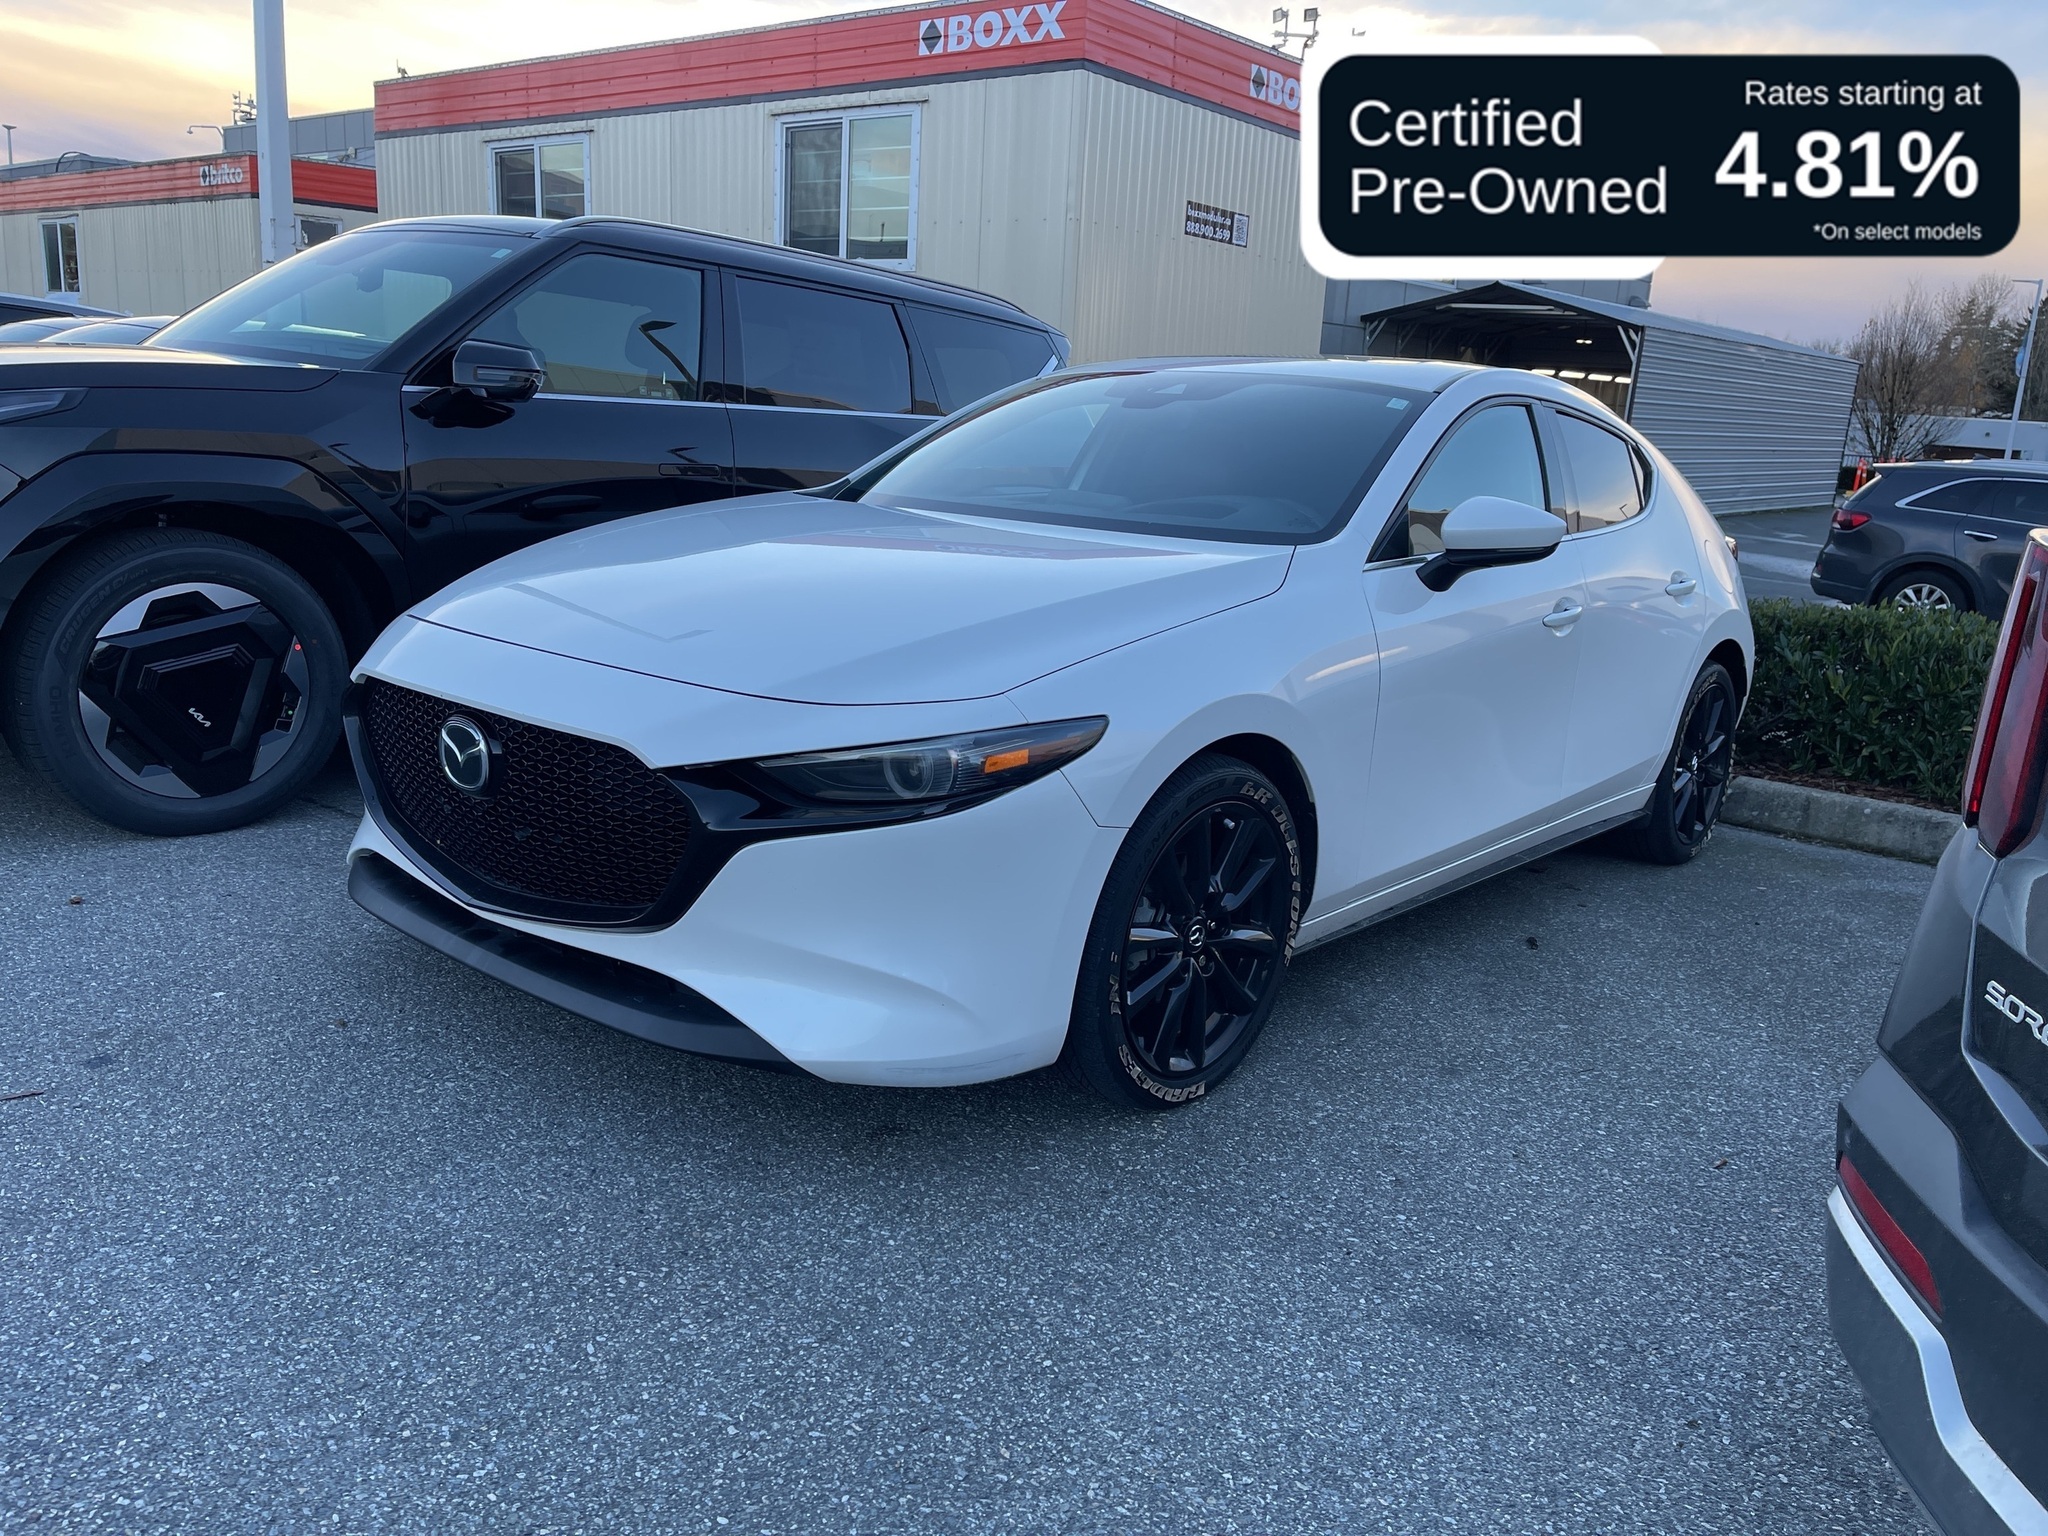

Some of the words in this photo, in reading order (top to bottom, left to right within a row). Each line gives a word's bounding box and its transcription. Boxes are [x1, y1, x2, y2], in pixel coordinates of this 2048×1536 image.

[948, 1, 1067, 52] BOXX
[1267, 70, 1301, 112] BO
[210, 163, 243, 186] britco
